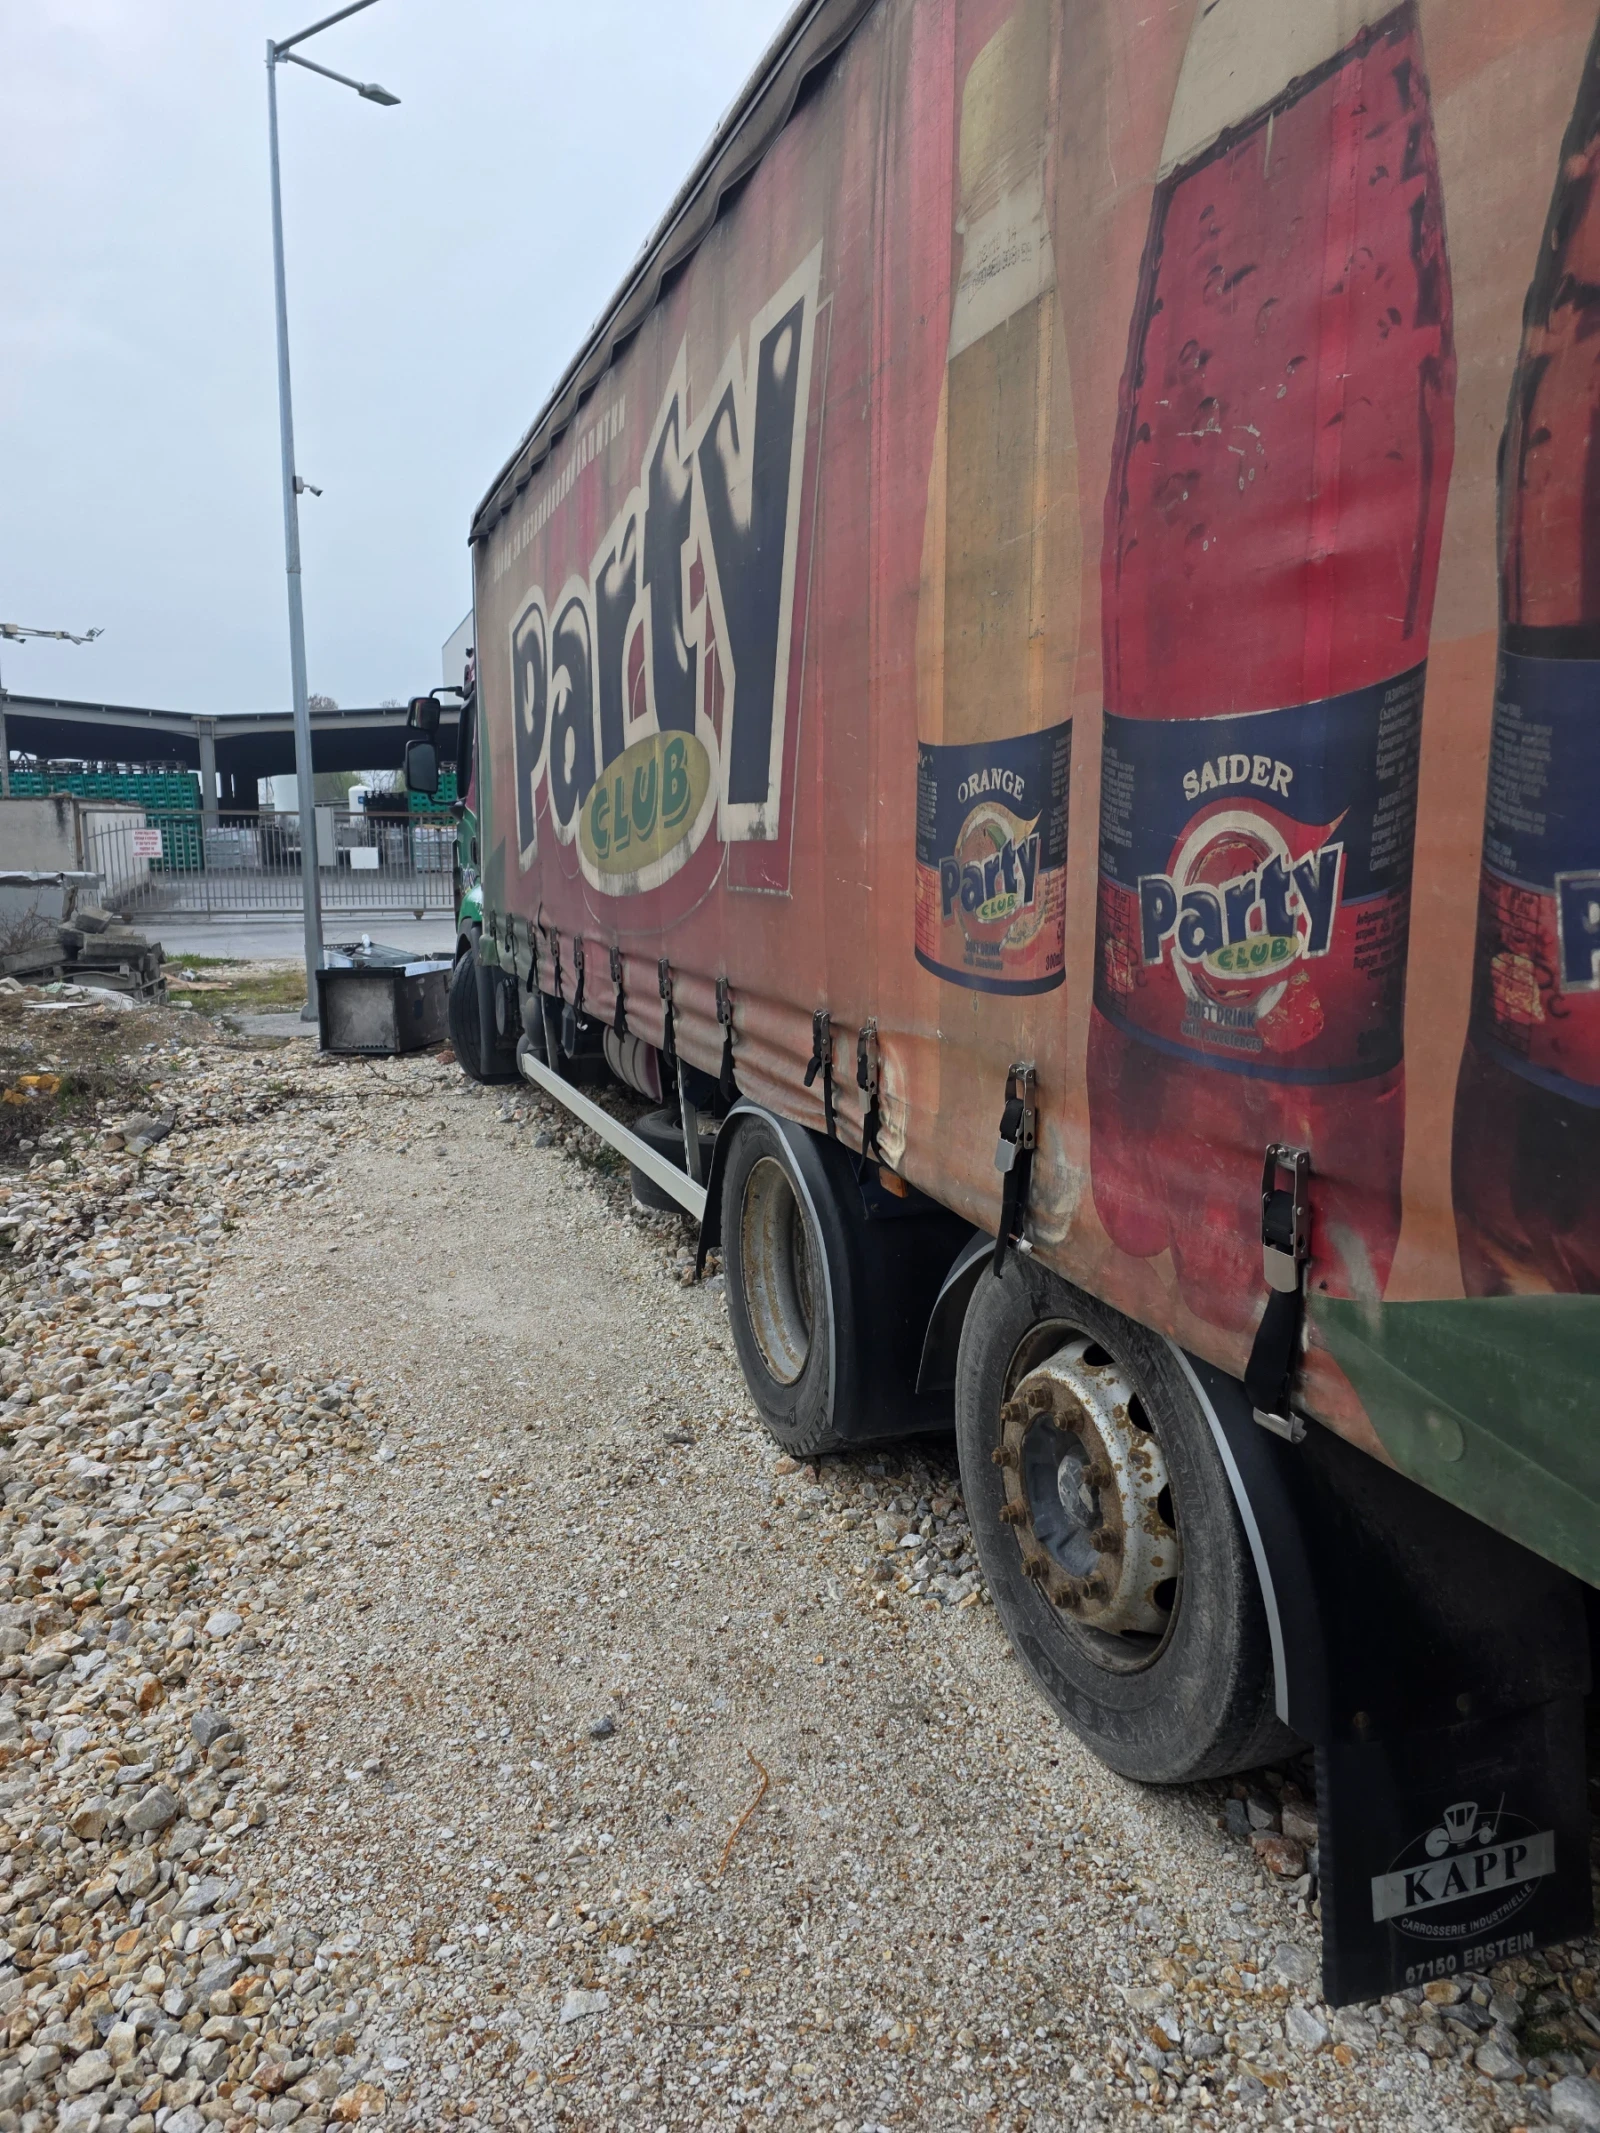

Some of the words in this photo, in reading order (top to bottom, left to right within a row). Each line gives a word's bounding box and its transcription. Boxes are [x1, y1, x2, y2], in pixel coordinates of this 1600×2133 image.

[589, 735, 692, 860] CLUB
[957, 767, 1025, 804] ORANGE
[1182, 753, 1294, 801] SAIDER
[980, 894, 1016, 921] CLUB
[1217, 938, 1291, 970] CLUB
[1185, 999, 1213, 1021] SOFT
[1216, 1006, 1257, 1029] DRINK
[1181, 1020, 1202, 1039] with
[1204, 1028, 1264, 1053] sweeteners
[1402, 1843, 1528, 1909] KAPP
[1401, 1917, 1467, 1937] CARROSSERIE
[1470, 1882, 1533, 1932] INDUSTRIELLE
[1405, 1953, 1457, 1984] 67150
[1463, 1931, 1535, 1968] ERSTEIN
